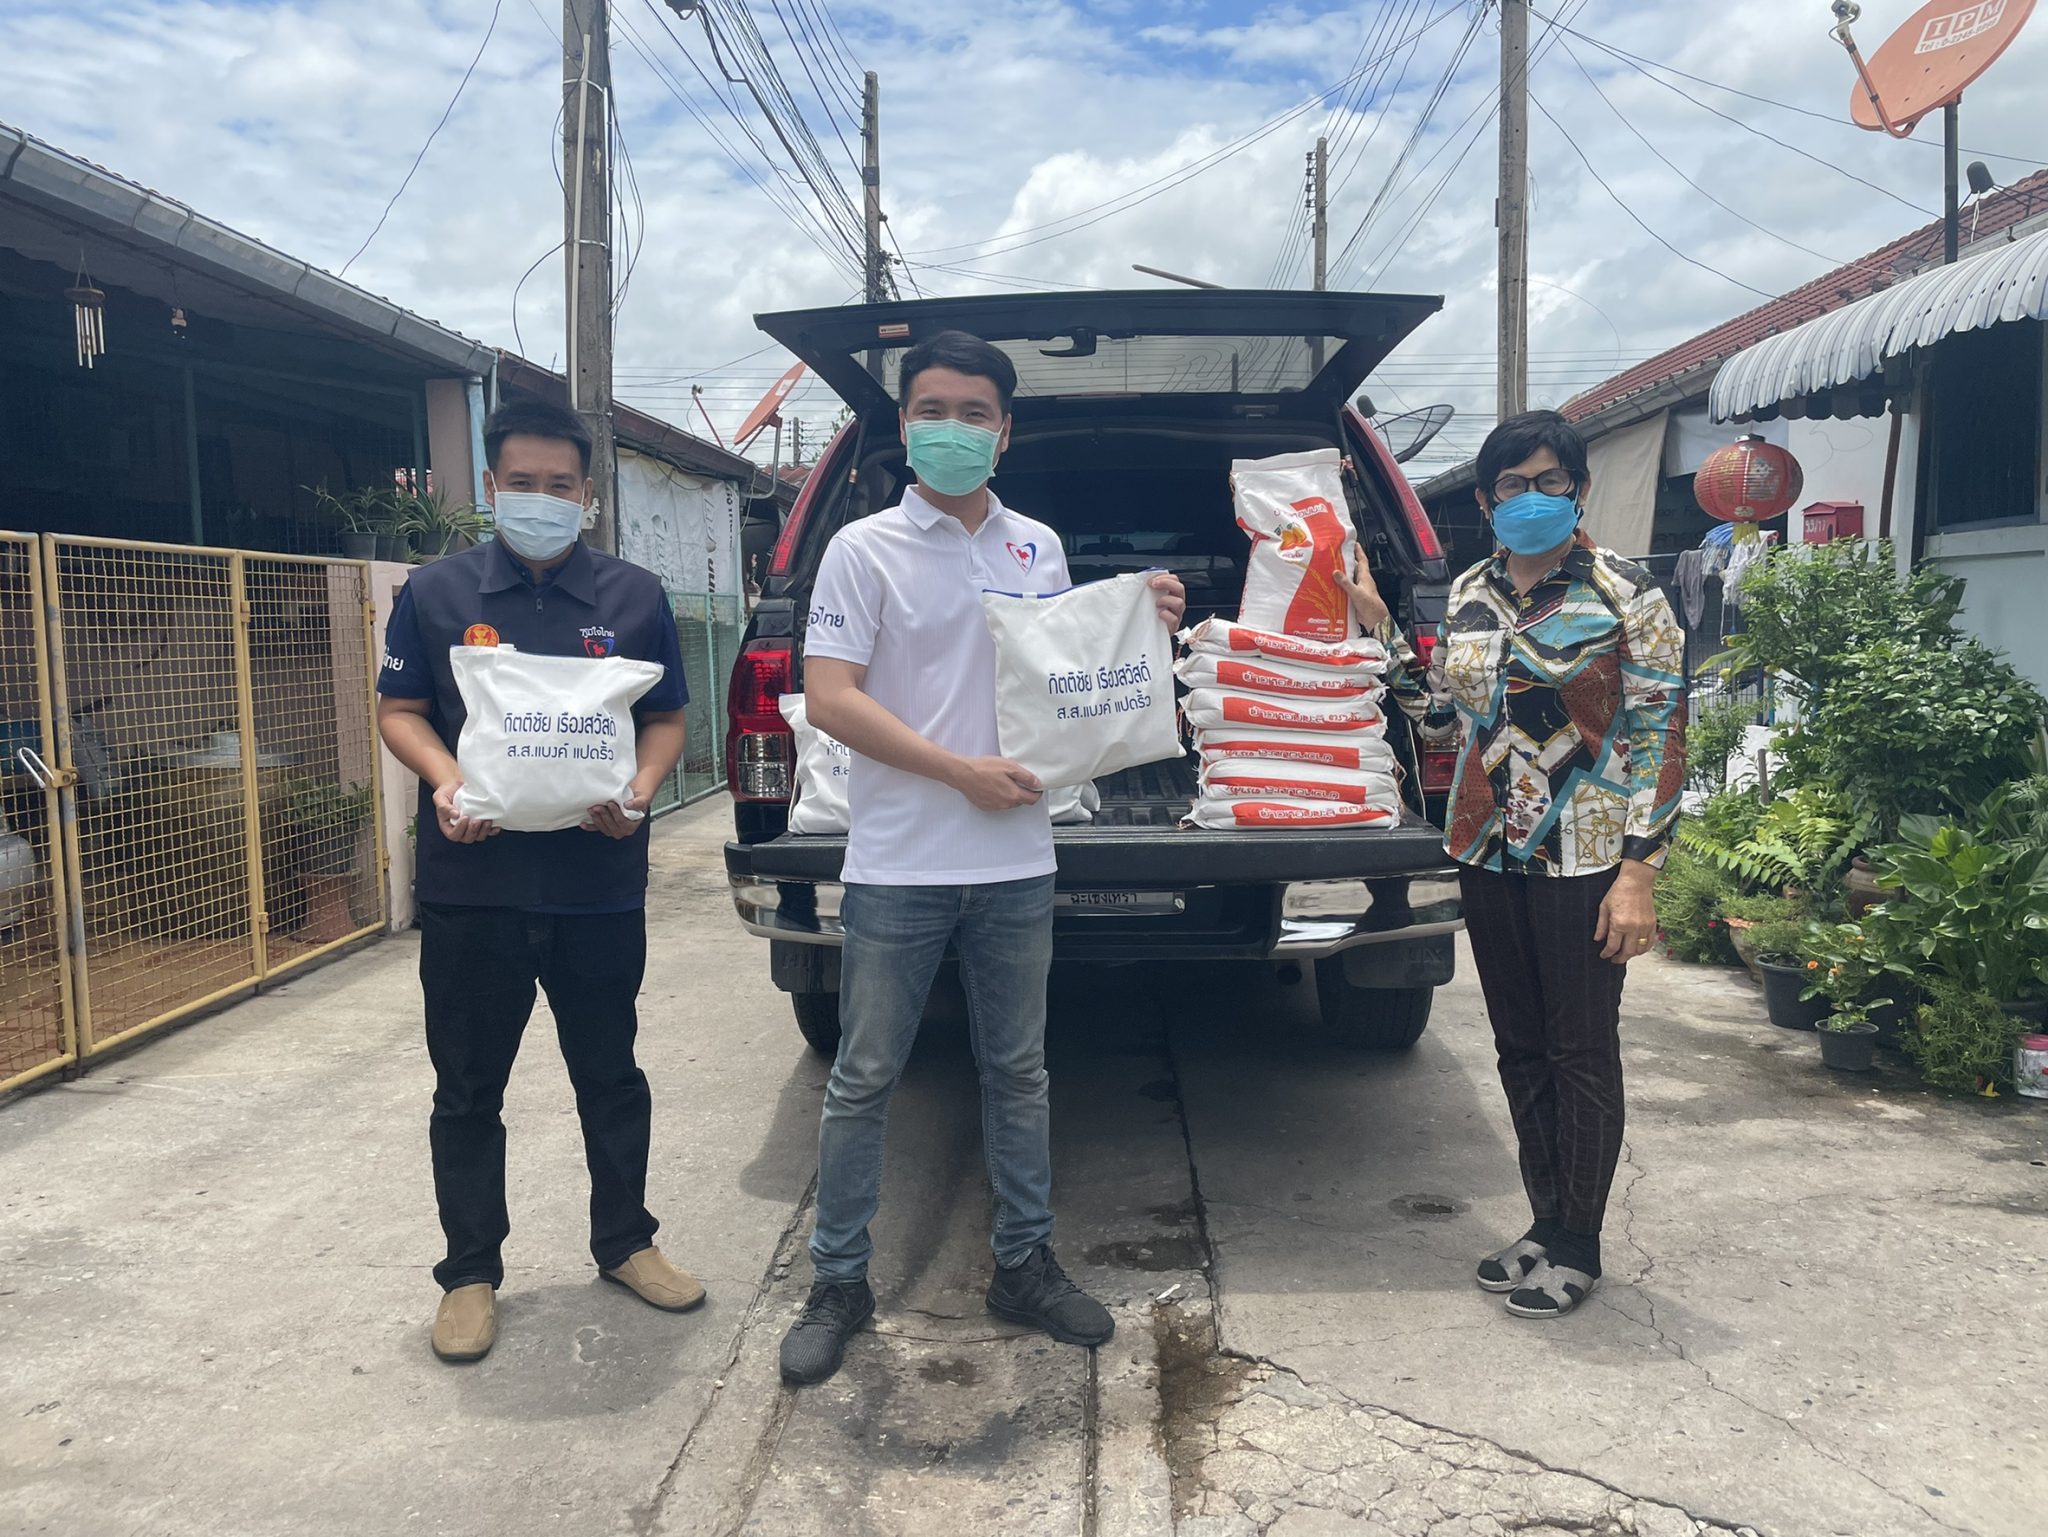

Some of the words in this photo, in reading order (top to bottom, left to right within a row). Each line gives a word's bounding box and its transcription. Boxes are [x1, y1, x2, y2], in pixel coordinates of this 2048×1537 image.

[1930, 2, 2001, 38] IPM
[1048, 669, 1093, 695] กิตติชัย
[1096, 653, 1152, 690] เรืองสวัสดิ์
[1242, 671, 1319, 690] ข้าวหอมมะลิ
[1056, 698, 1112, 720] ส.ส.แบงค์
[1114, 689, 1152, 713] แปดริ้ว
[1249, 705, 1327, 724] ข้าวหอมมะลิ
[504, 711, 552, 734] กิตติชัย
[507, 742, 569, 759] ส.ส.แบงค์
[573, 740, 615, 761] แปดริ้ว
